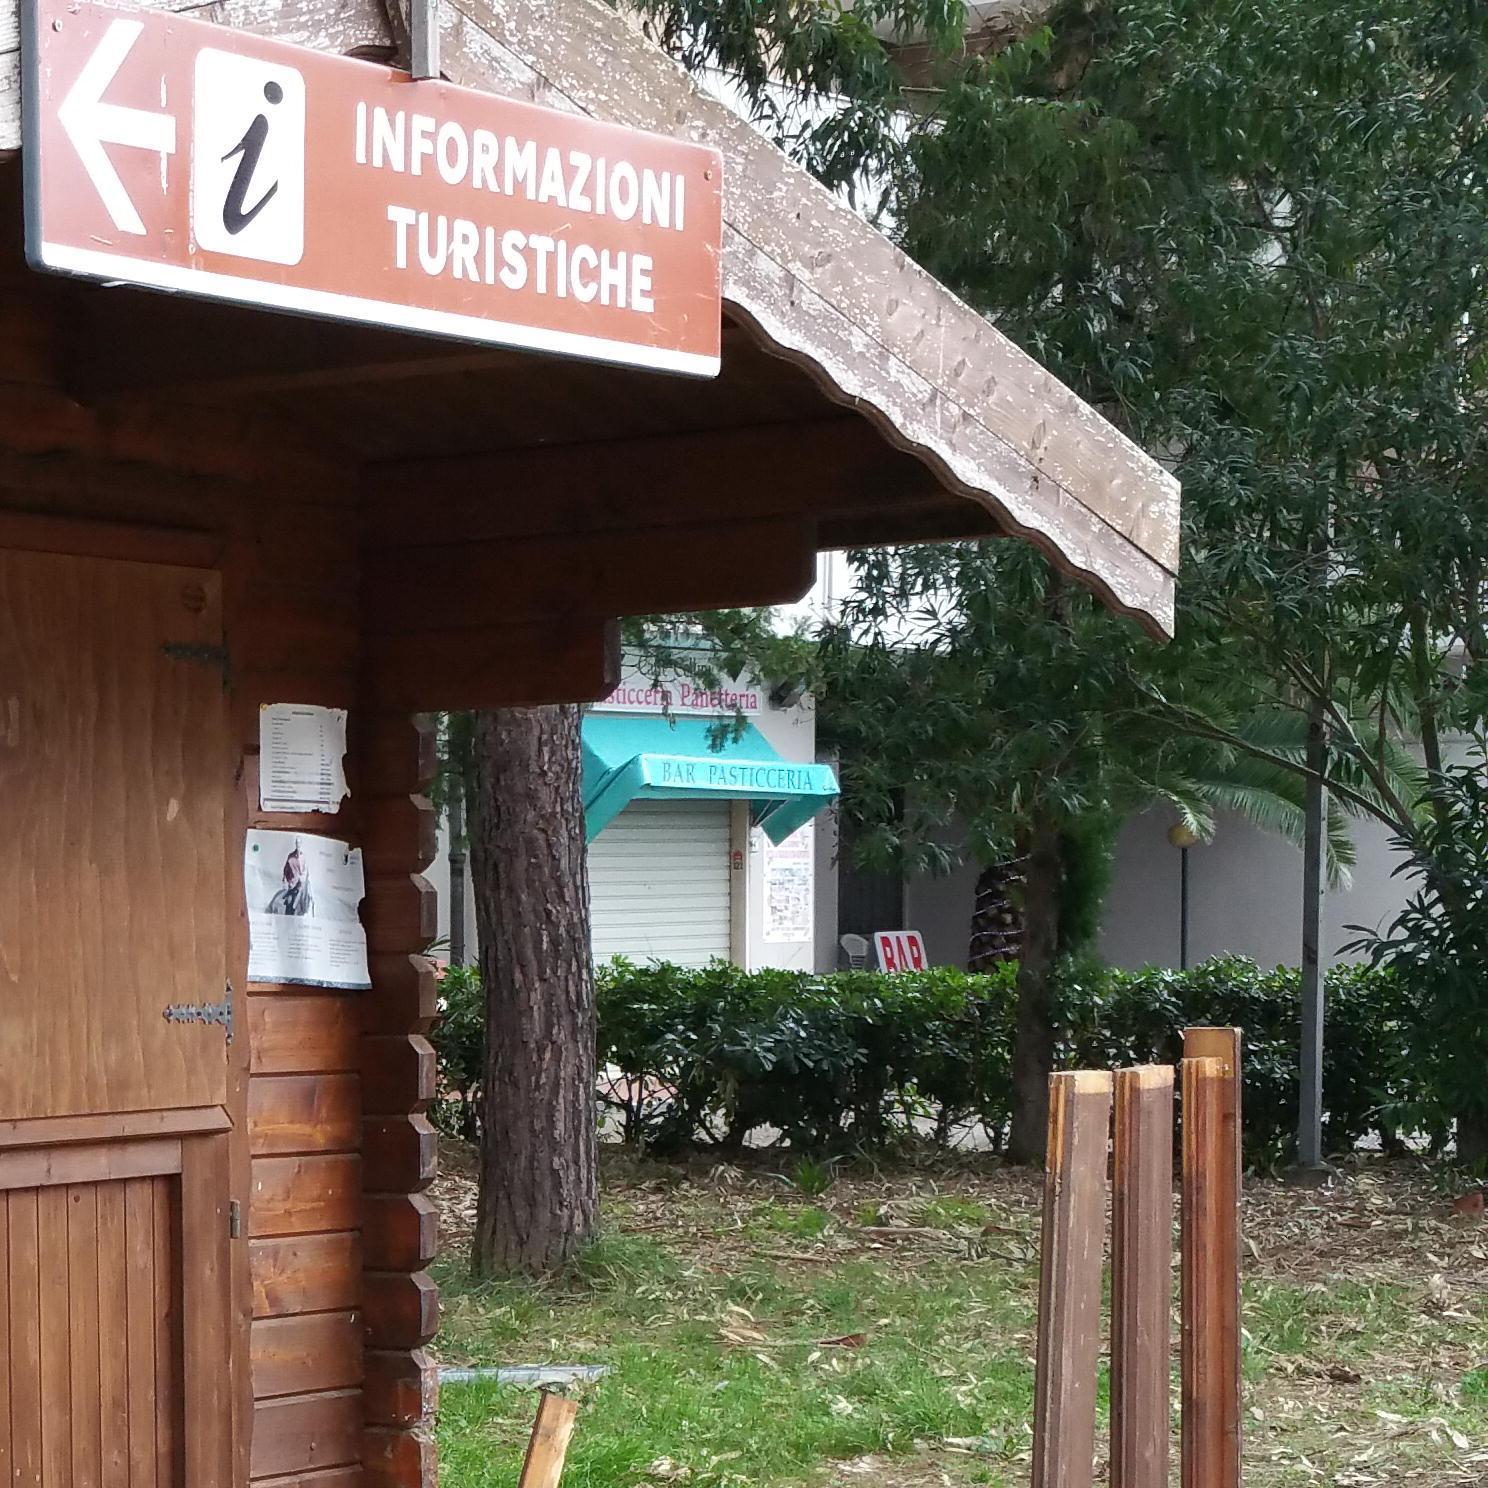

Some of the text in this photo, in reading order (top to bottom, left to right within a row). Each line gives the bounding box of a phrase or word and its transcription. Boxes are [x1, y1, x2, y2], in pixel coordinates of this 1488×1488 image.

[356, 101, 686, 232] INFORMAZIONI
[387, 205, 656, 313] TURISTICHE
[663, 762, 813, 791] BAR PASTICCERIA
[879, 935, 923, 972] BAR
